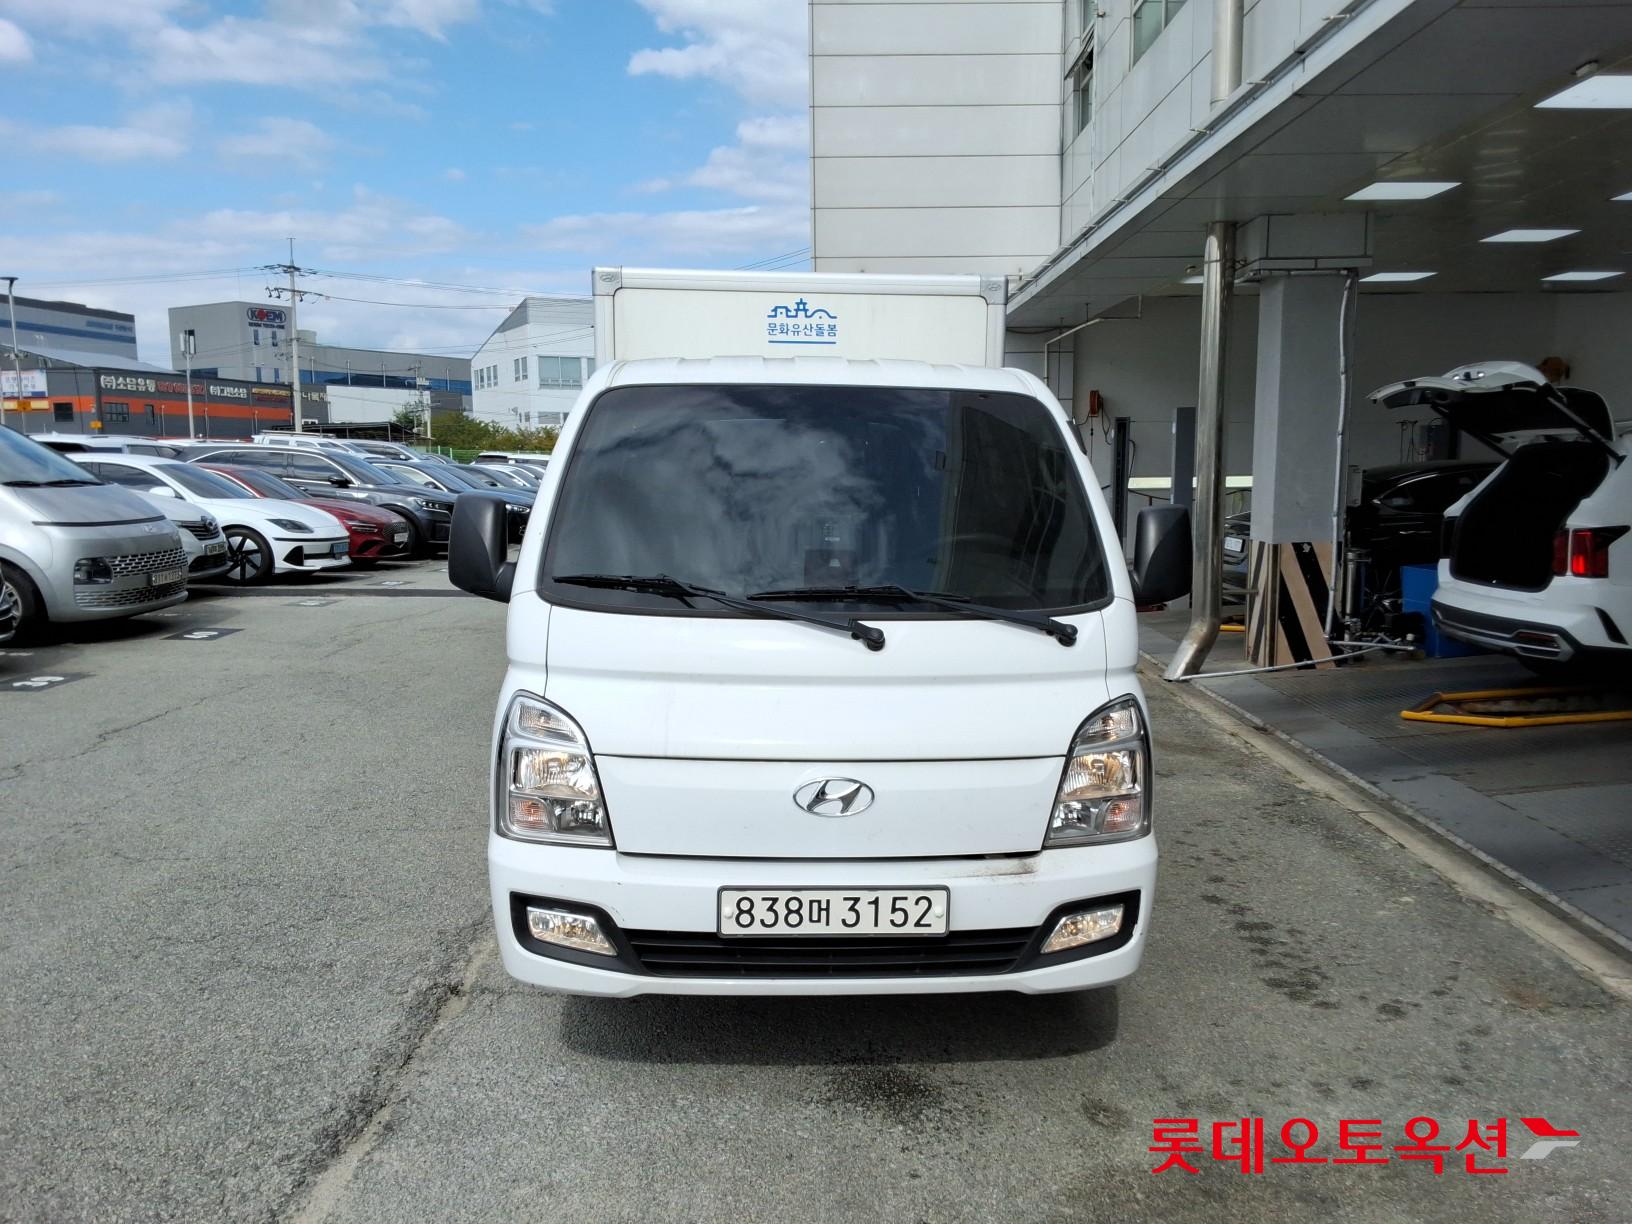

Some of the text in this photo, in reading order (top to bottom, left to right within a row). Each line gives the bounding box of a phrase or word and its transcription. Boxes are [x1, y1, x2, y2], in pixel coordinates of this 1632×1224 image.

[767, 322, 838, 337] 문화유산돌봄
[735, 895, 933, 928] 838머 3152
